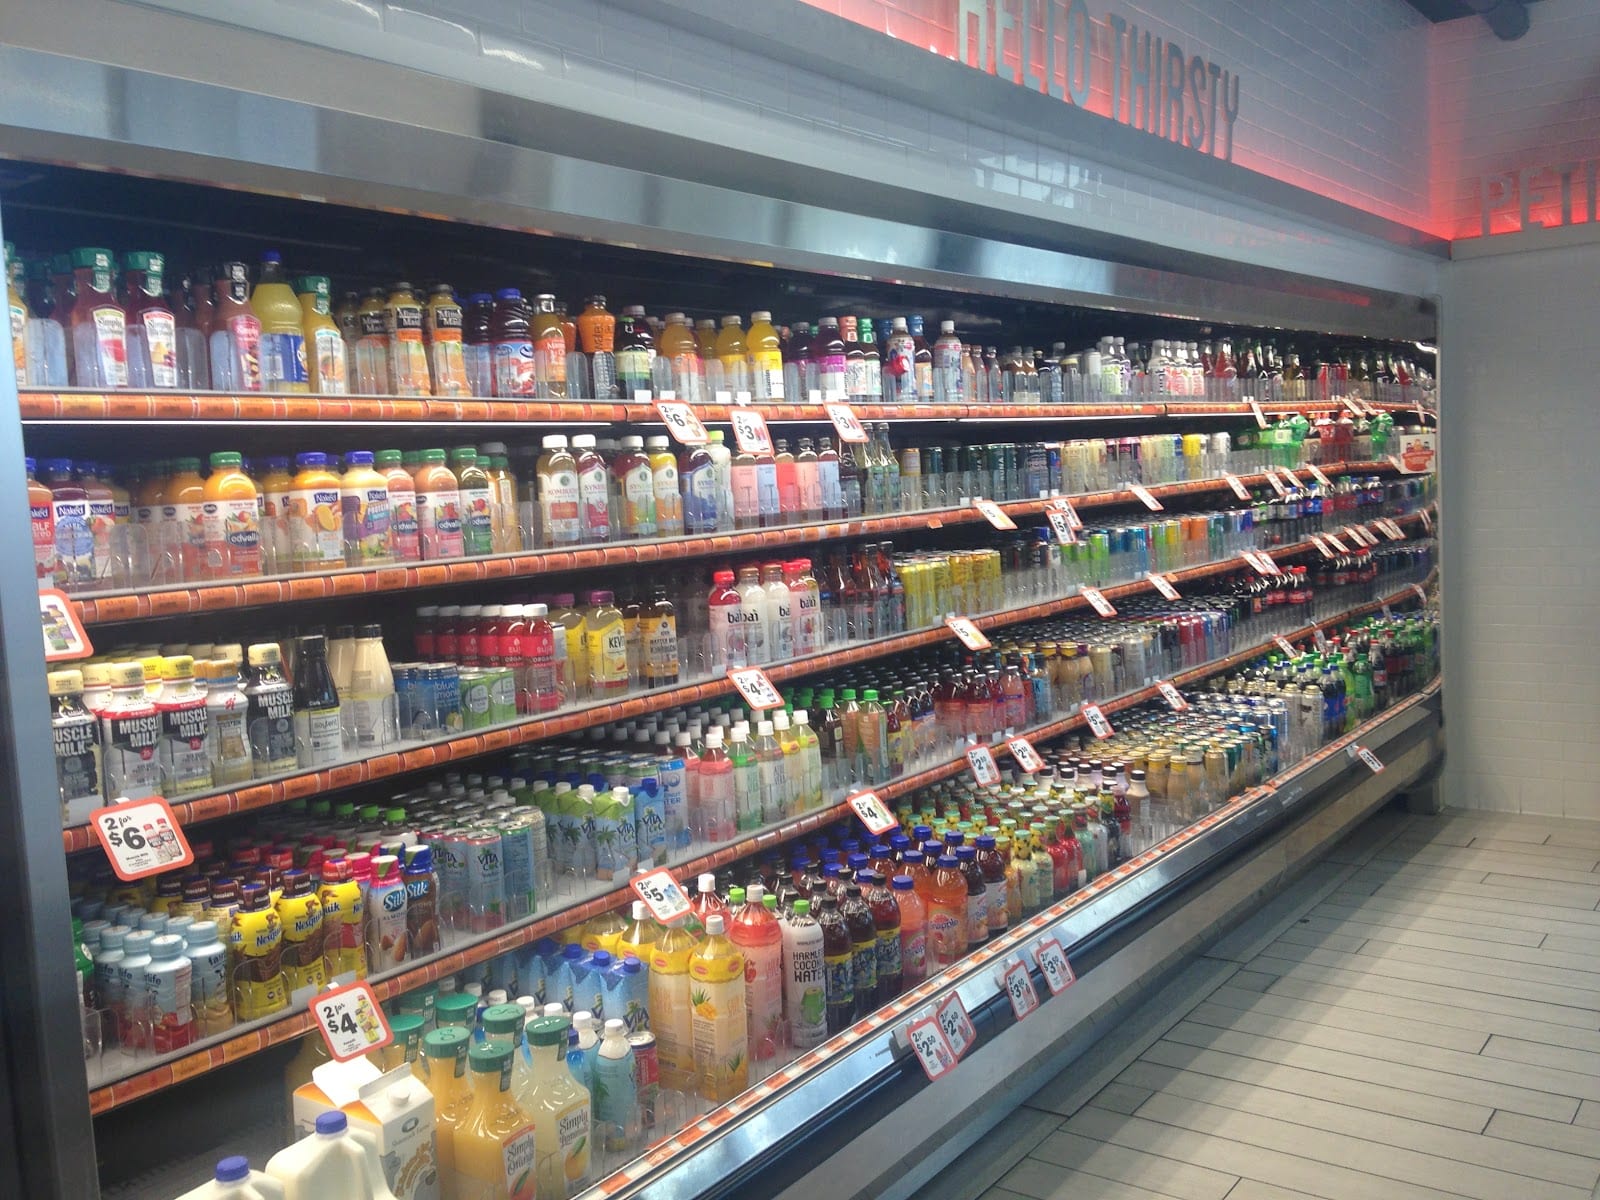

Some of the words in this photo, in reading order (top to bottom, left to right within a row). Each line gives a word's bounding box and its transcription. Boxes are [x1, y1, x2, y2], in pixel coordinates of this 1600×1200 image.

[957, 0, 1091, 108] HELLO
[1106, 12, 1240, 163] THIRSTY
[58, 505, 85, 517] Naked
[434, 680, 455, 690] blue
[268, 704, 292, 720] MILK
[180, 721, 206, 738] MILK
[130, 730, 158, 748] MILK
[55, 740, 87, 757] MILK
[104, 817, 119, 831] 2
[118, 815, 132, 828] for
[641, 814, 663, 825] VITA
[616, 822, 635, 836] VITA
[108, 826, 146, 850] $6
[477, 852, 499, 865] VITA
[406, 881, 429, 897] Silk
[637, 881, 646, 890] 2
[384, 889, 405, 910] Silk
[643, 887, 665, 902] $5
[323, 1006, 335, 1019] 2
[334, 1002, 346, 1015] for
[327, 1012, 358, 1035] $4
[912, 1032, 919, 1043] 2
[559, 1108, 589, 1133] Simply
[507, 1134, 534, 1156] Simply
